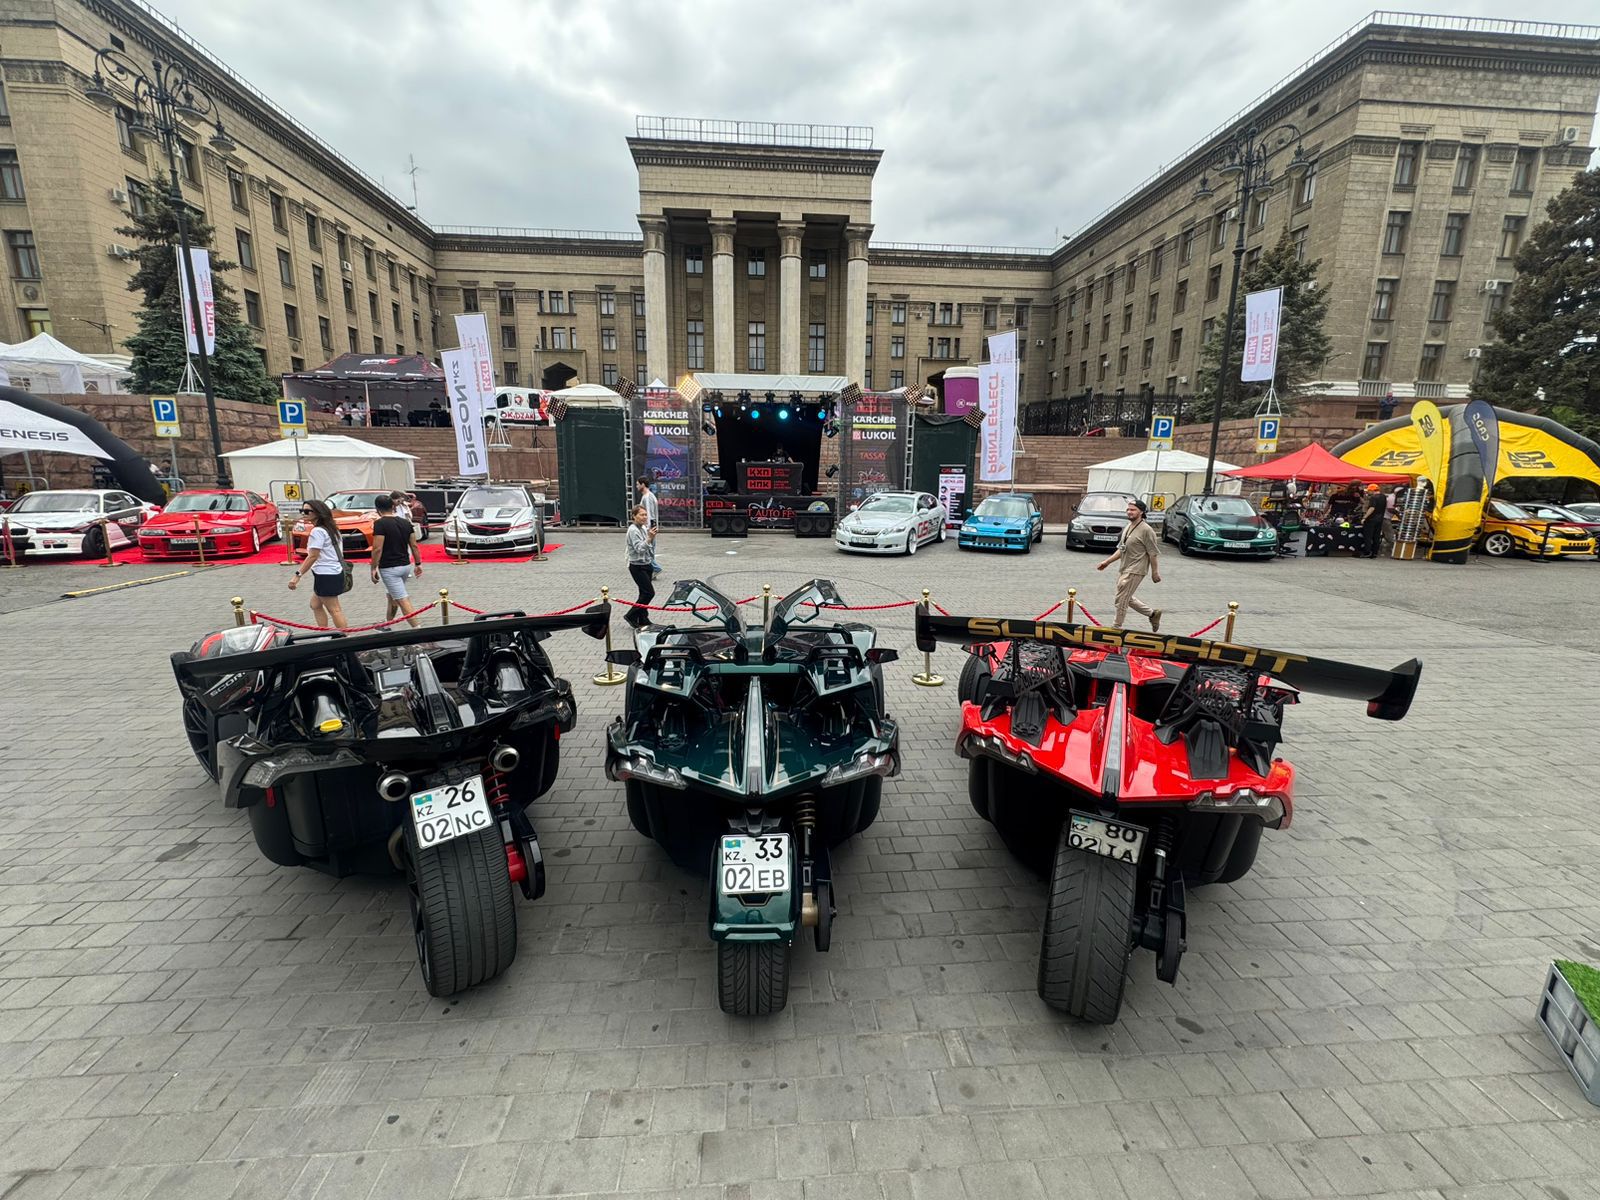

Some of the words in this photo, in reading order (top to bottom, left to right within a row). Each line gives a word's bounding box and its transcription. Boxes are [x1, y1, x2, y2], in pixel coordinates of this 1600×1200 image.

[158, 401, 172, 420] P
[285, 403, 299, 422] P
[0, 429, 69, 441] ENESIS
[654, 426, 691, 435] LUKOIL
[862, 431, 897, 440] LUKOIL
[1157, 419, 1170, 437] P
[1263, 421, 1275, 438] P
[755, 509, 780, 517] AUTO
[967, 616, 1309, 674] SLINGSHOT
[210, 672, 246, 697] SCOR
[416, 805, 434, 818] KZ
[444, 781, 475, 809] 26
[422, 818, 452, 843] 02
[455, 810, 486, 833] NC
[1072, 822, 1088, 831] KZ
[1105, 823, 1137, 843] 80
[725, 851, 740, 861] KZ
[755, 837, 783, 859] 33
[1070, 833, 1098, 853] 02
[725, 867, 751, 890] 02
[758, 869, 785, 888] EB
